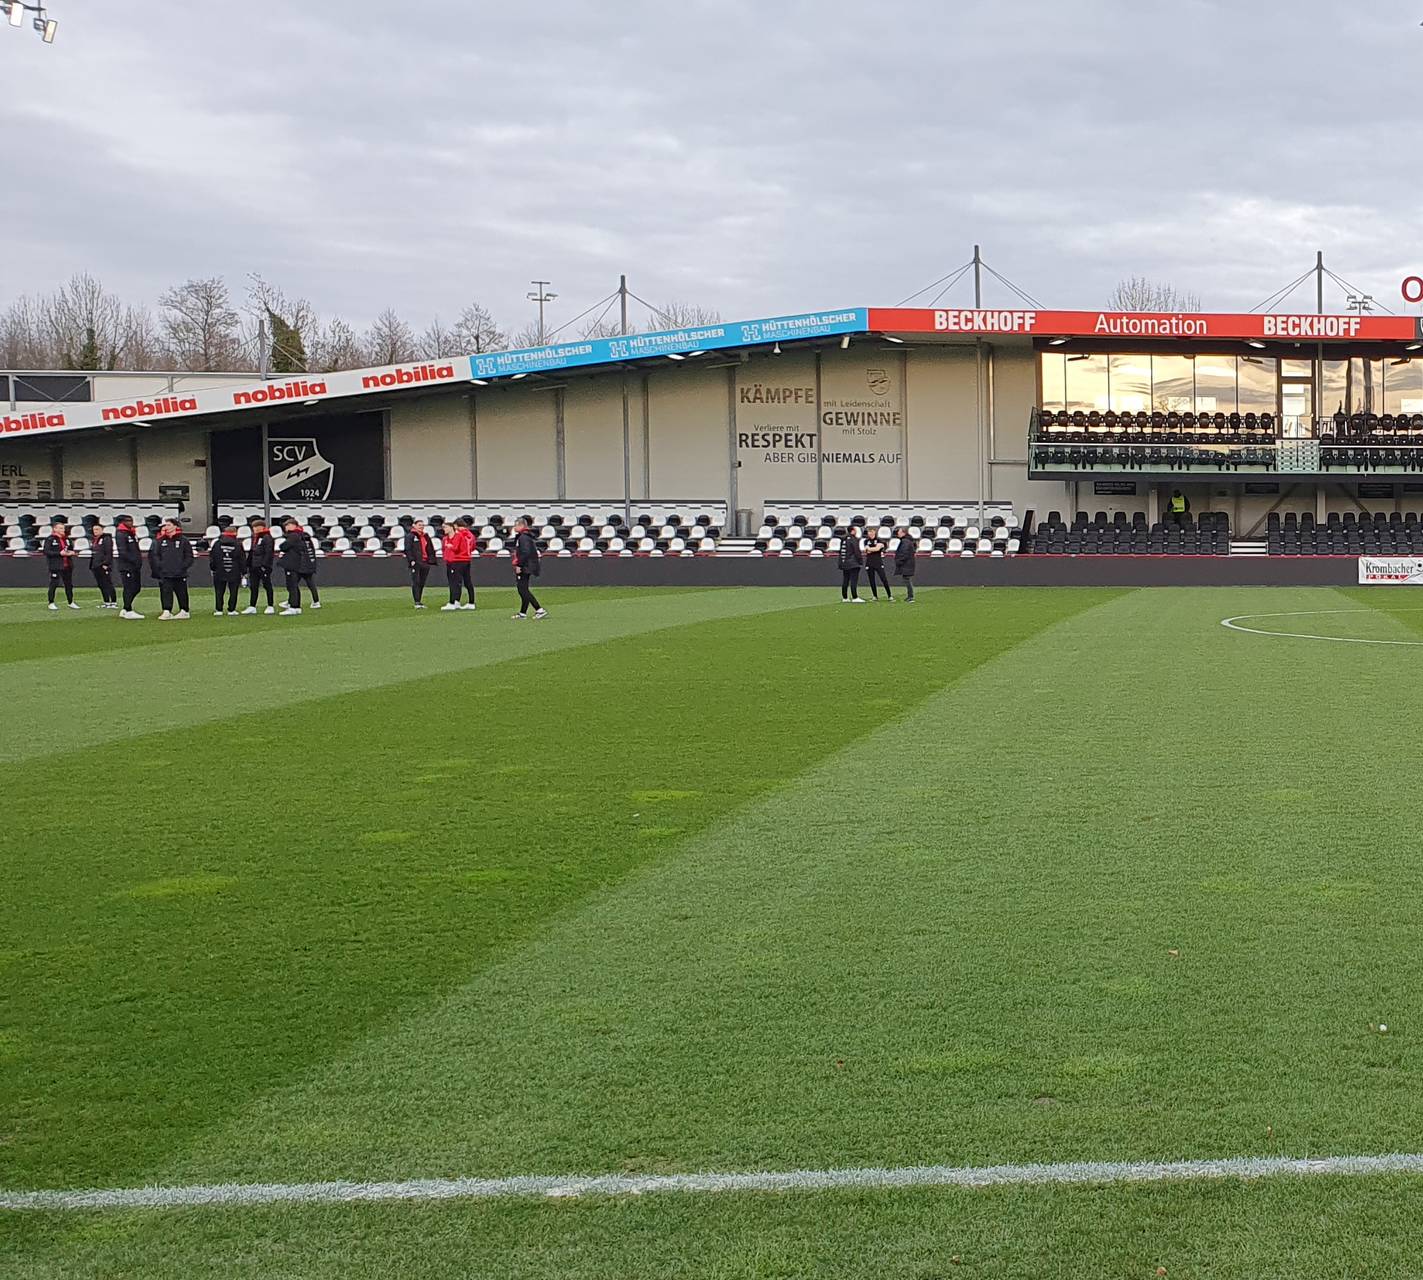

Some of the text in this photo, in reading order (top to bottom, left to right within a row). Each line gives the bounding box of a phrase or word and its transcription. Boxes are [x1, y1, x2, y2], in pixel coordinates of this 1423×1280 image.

[762, 312, 857, 331] HÜTTENHÖLSCHER
[934, 311, 1036, 332] BECKHOFF
[1095, 314, 1207, 335] Automation
[1263, 316, 1361, 336] BECKHOFF
[629, 328, 725, 348] HÜTTENHÖLSCHER
[496, 345, 593, 365] HÜTTENHÖLSCHER
[362, 365, 454, 388] nobilia
[233, 380, 327, 405] nobilia
[740, 384, 815, 404] KÄMPFE
[101, 396, 198, 420] nobilia
[823, 400, 891, 408] mit Leidenschaft
[754, 424, 800, 432] Verliere mit
[823, 411, 902, 427] GEWINNE
[842, 427, 877, 435] mit Stolz
[738, 433, 817, 449] RESPEKT
[273, 446, 306, 461] SCV
[764, 452, 902, 464] ABER GIB NIEMALS AUF
[300, 489, 320, 497] 1924
[1366, 562, 1414, 574] Krombacher
